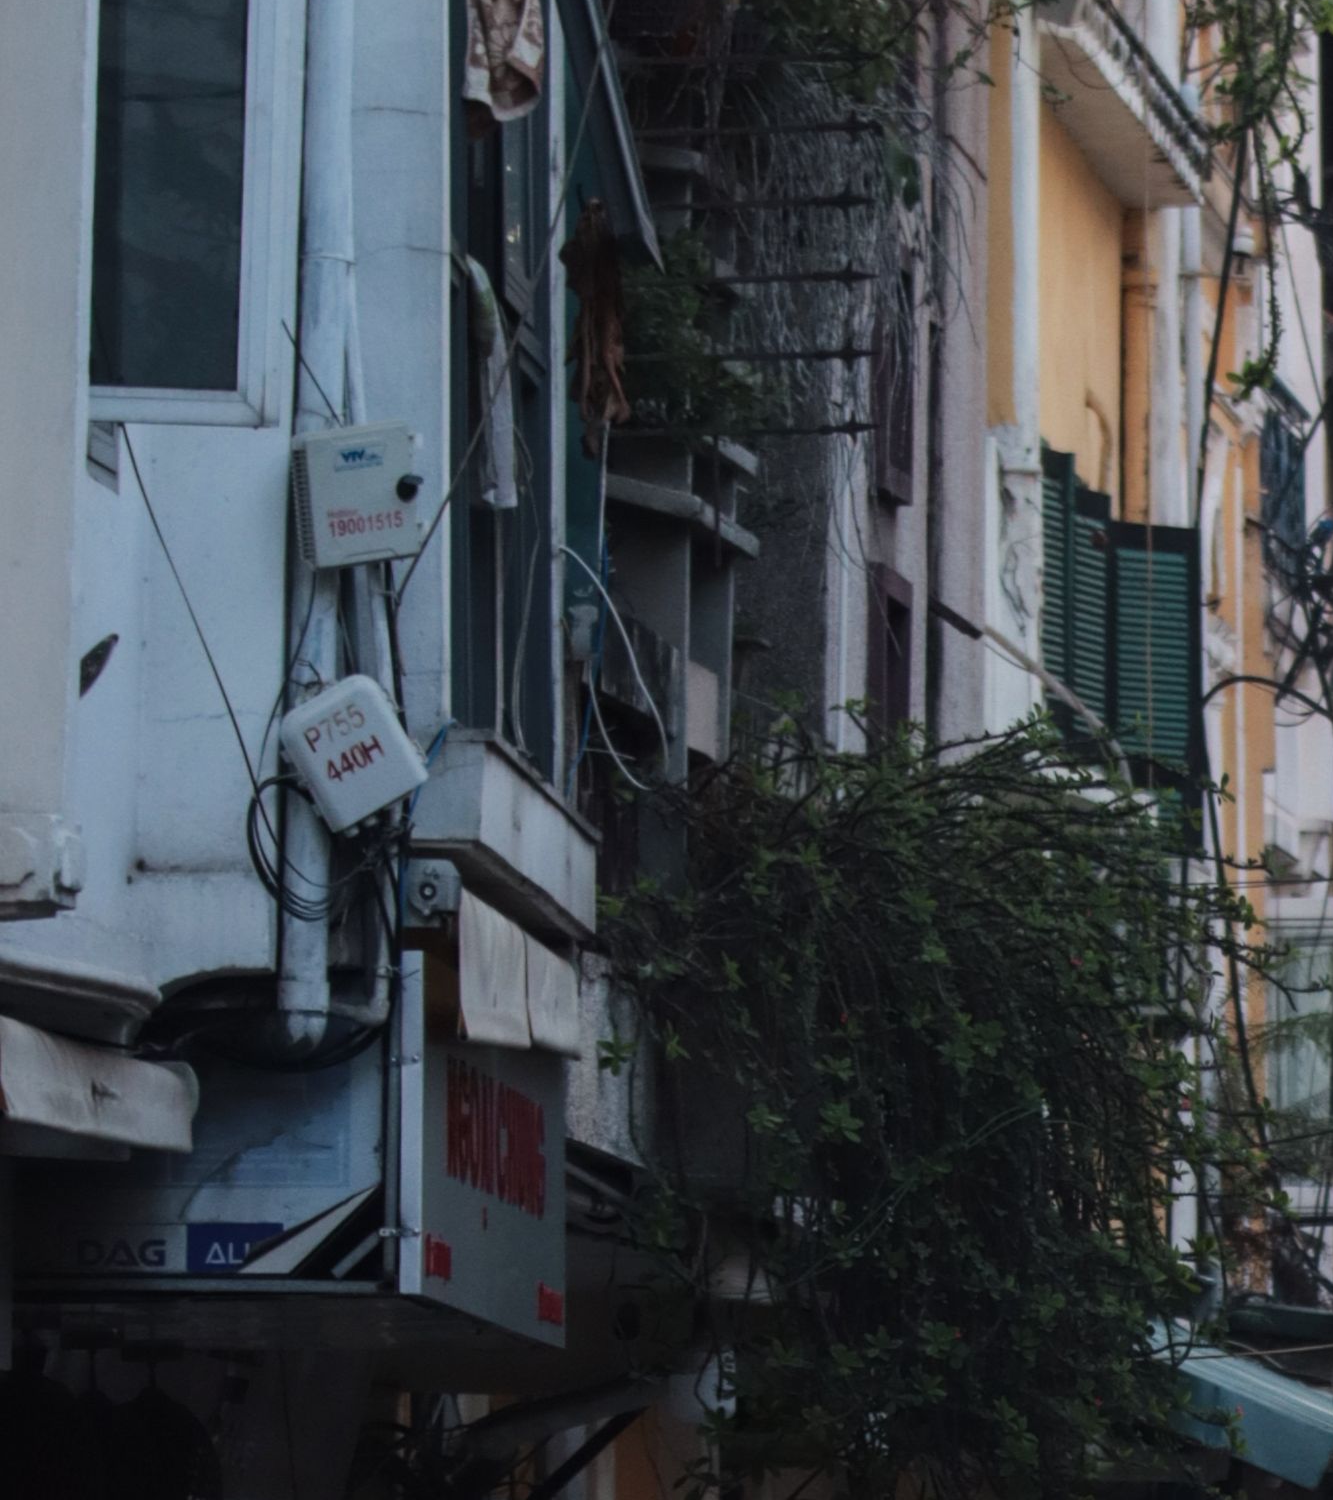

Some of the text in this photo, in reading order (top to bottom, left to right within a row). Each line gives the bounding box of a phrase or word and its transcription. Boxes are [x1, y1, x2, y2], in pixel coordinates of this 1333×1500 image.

[304, 704, 367, 754] P755
[327, 735, 385, 782] 440H
[77, 1239, 169, 1267] DAG
